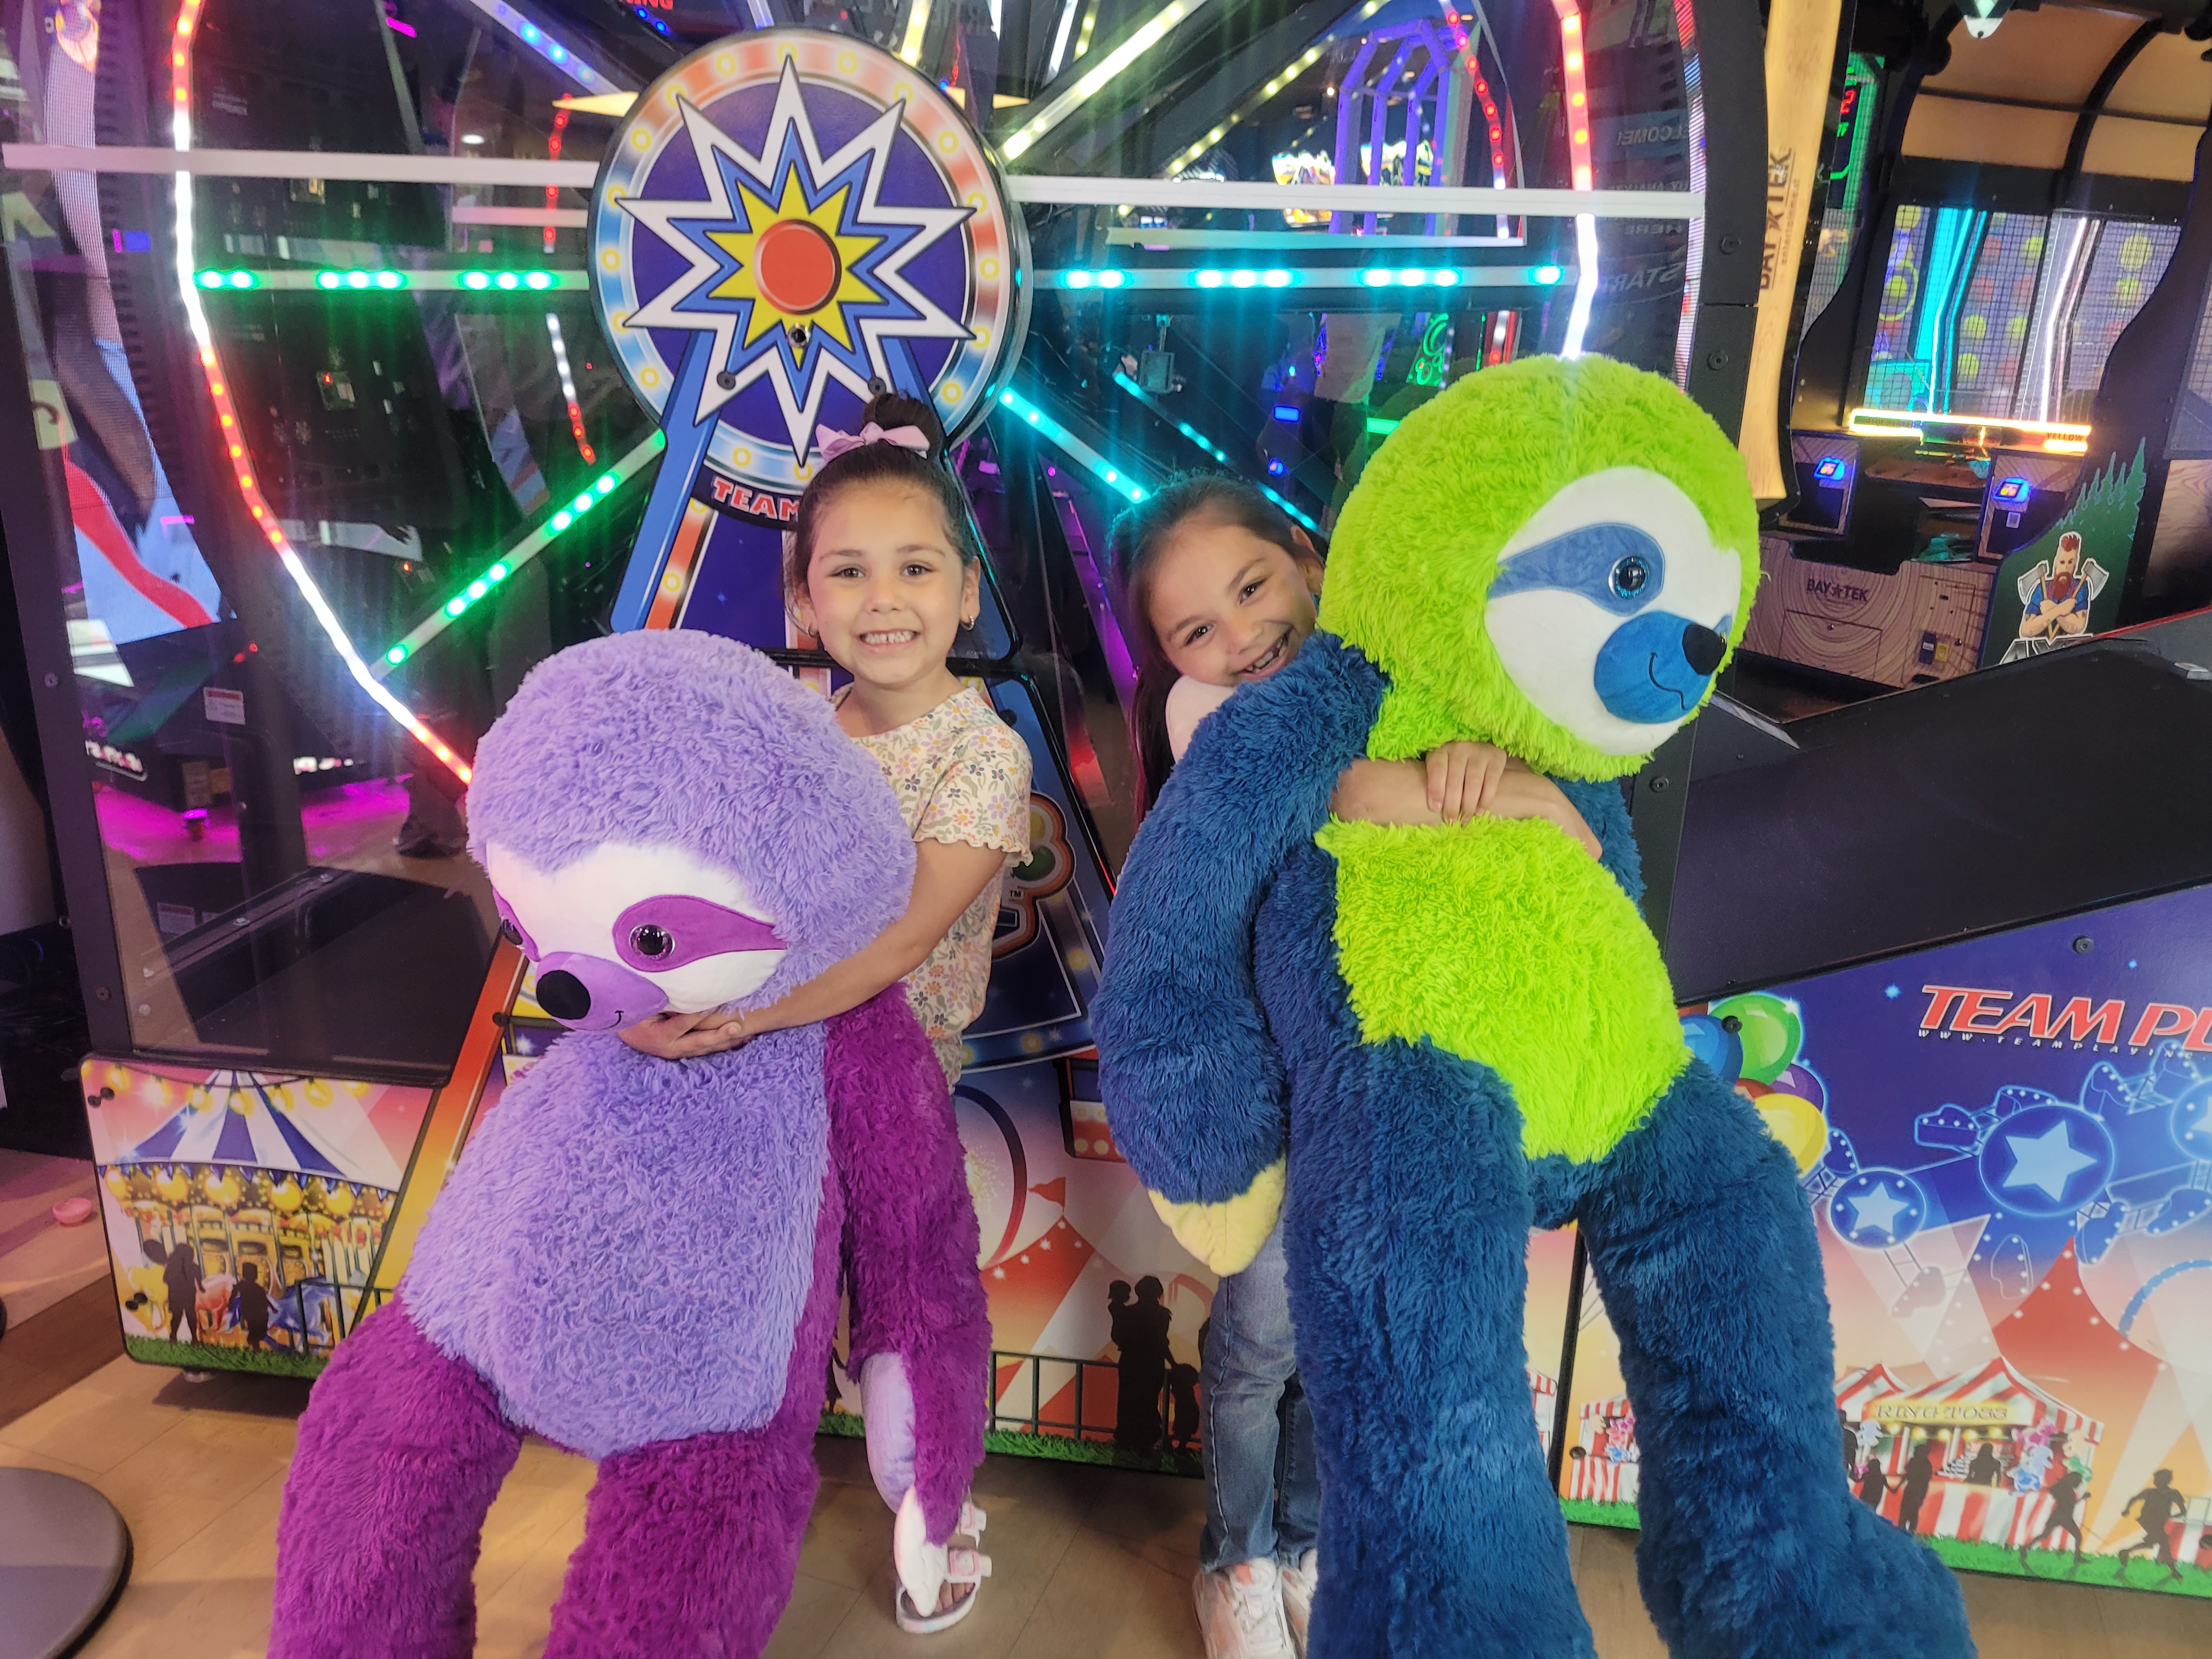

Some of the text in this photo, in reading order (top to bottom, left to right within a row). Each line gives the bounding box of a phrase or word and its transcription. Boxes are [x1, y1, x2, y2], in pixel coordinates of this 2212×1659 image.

[2047, 432, 2084, 442] YELLOW
[713, 476, 799, 522] TEAM
[1807, 579, 1869, 603] BAY TEK
[1920, 985, 2125, 1044] TEAM
[1875, 1405, 2007, 1420] RING TOSS
